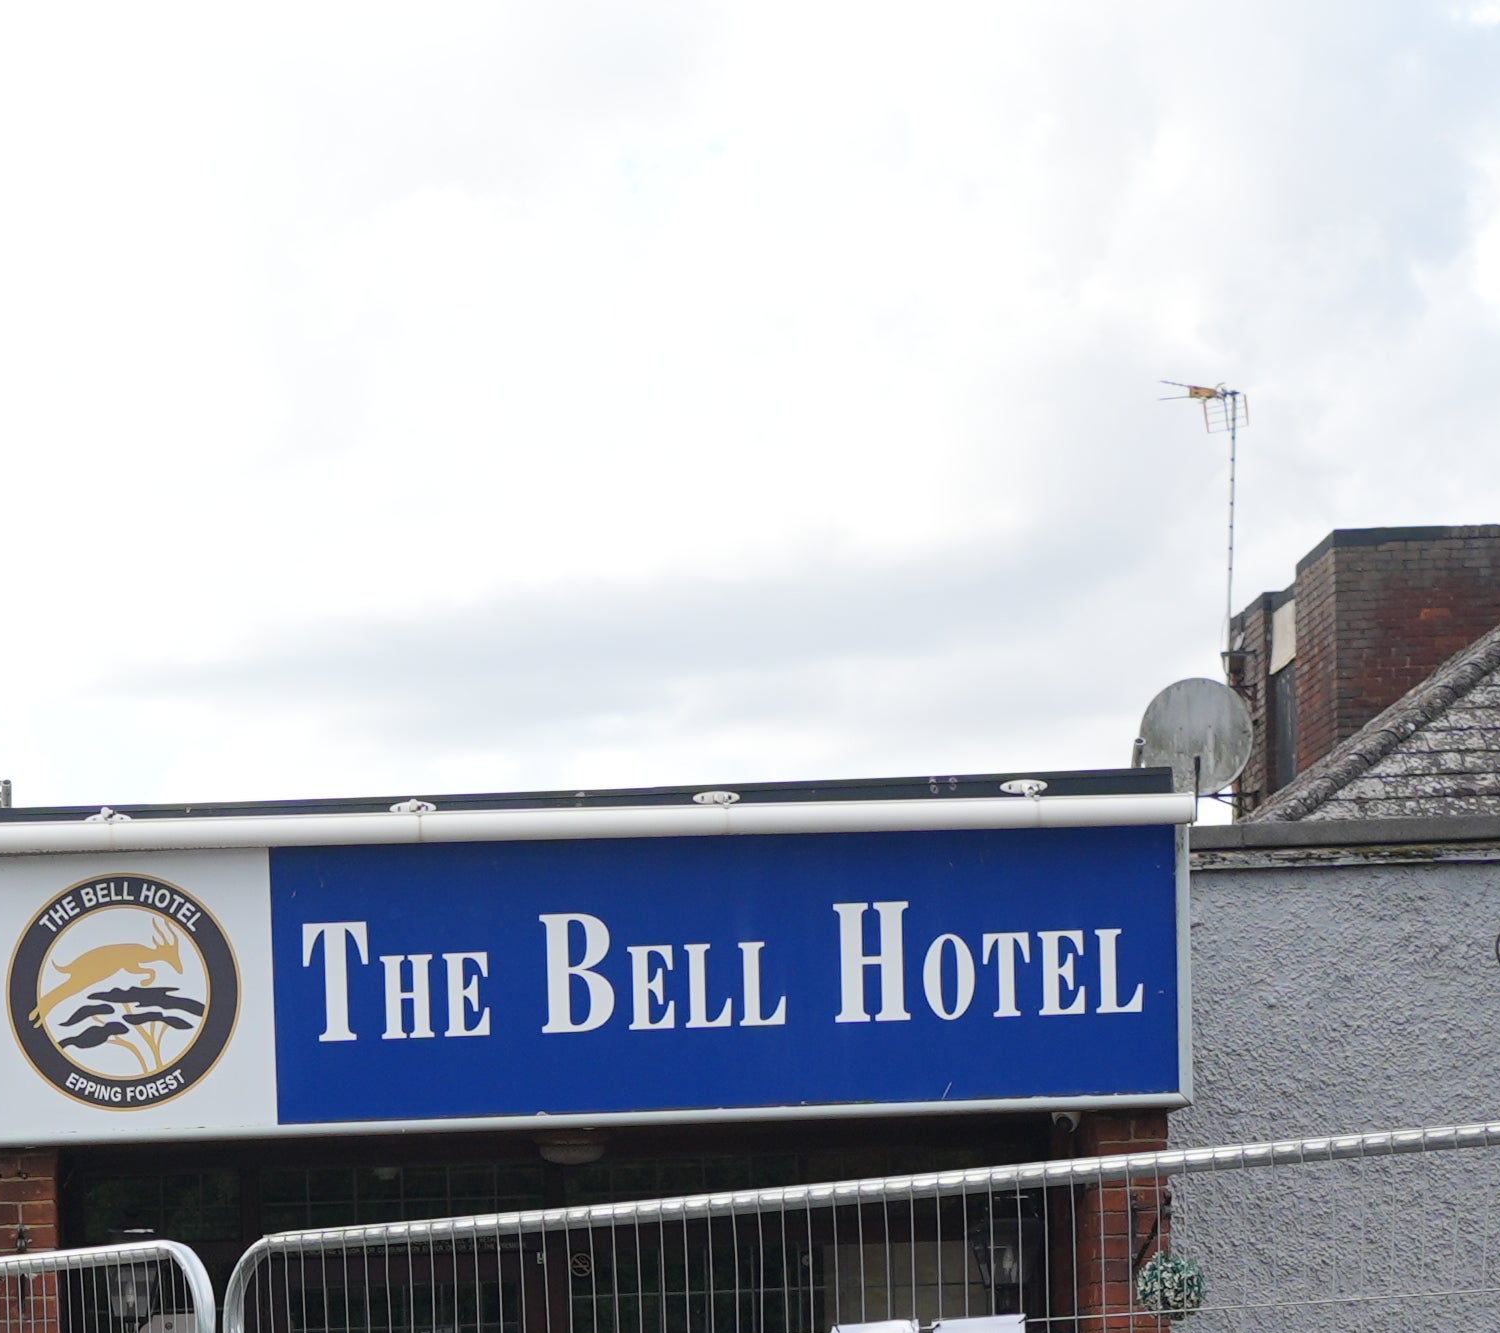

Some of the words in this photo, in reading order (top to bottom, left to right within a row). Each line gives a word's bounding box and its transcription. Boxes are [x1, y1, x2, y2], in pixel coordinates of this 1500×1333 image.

[39, 895, 80, 932] THE
[80, 881, 135, 908] BELL
[140, 883, 201, 932] HOTEL
[65, 1072, 122, 1102] EPPING
[126, 1069, 185, 1102] FOREST
